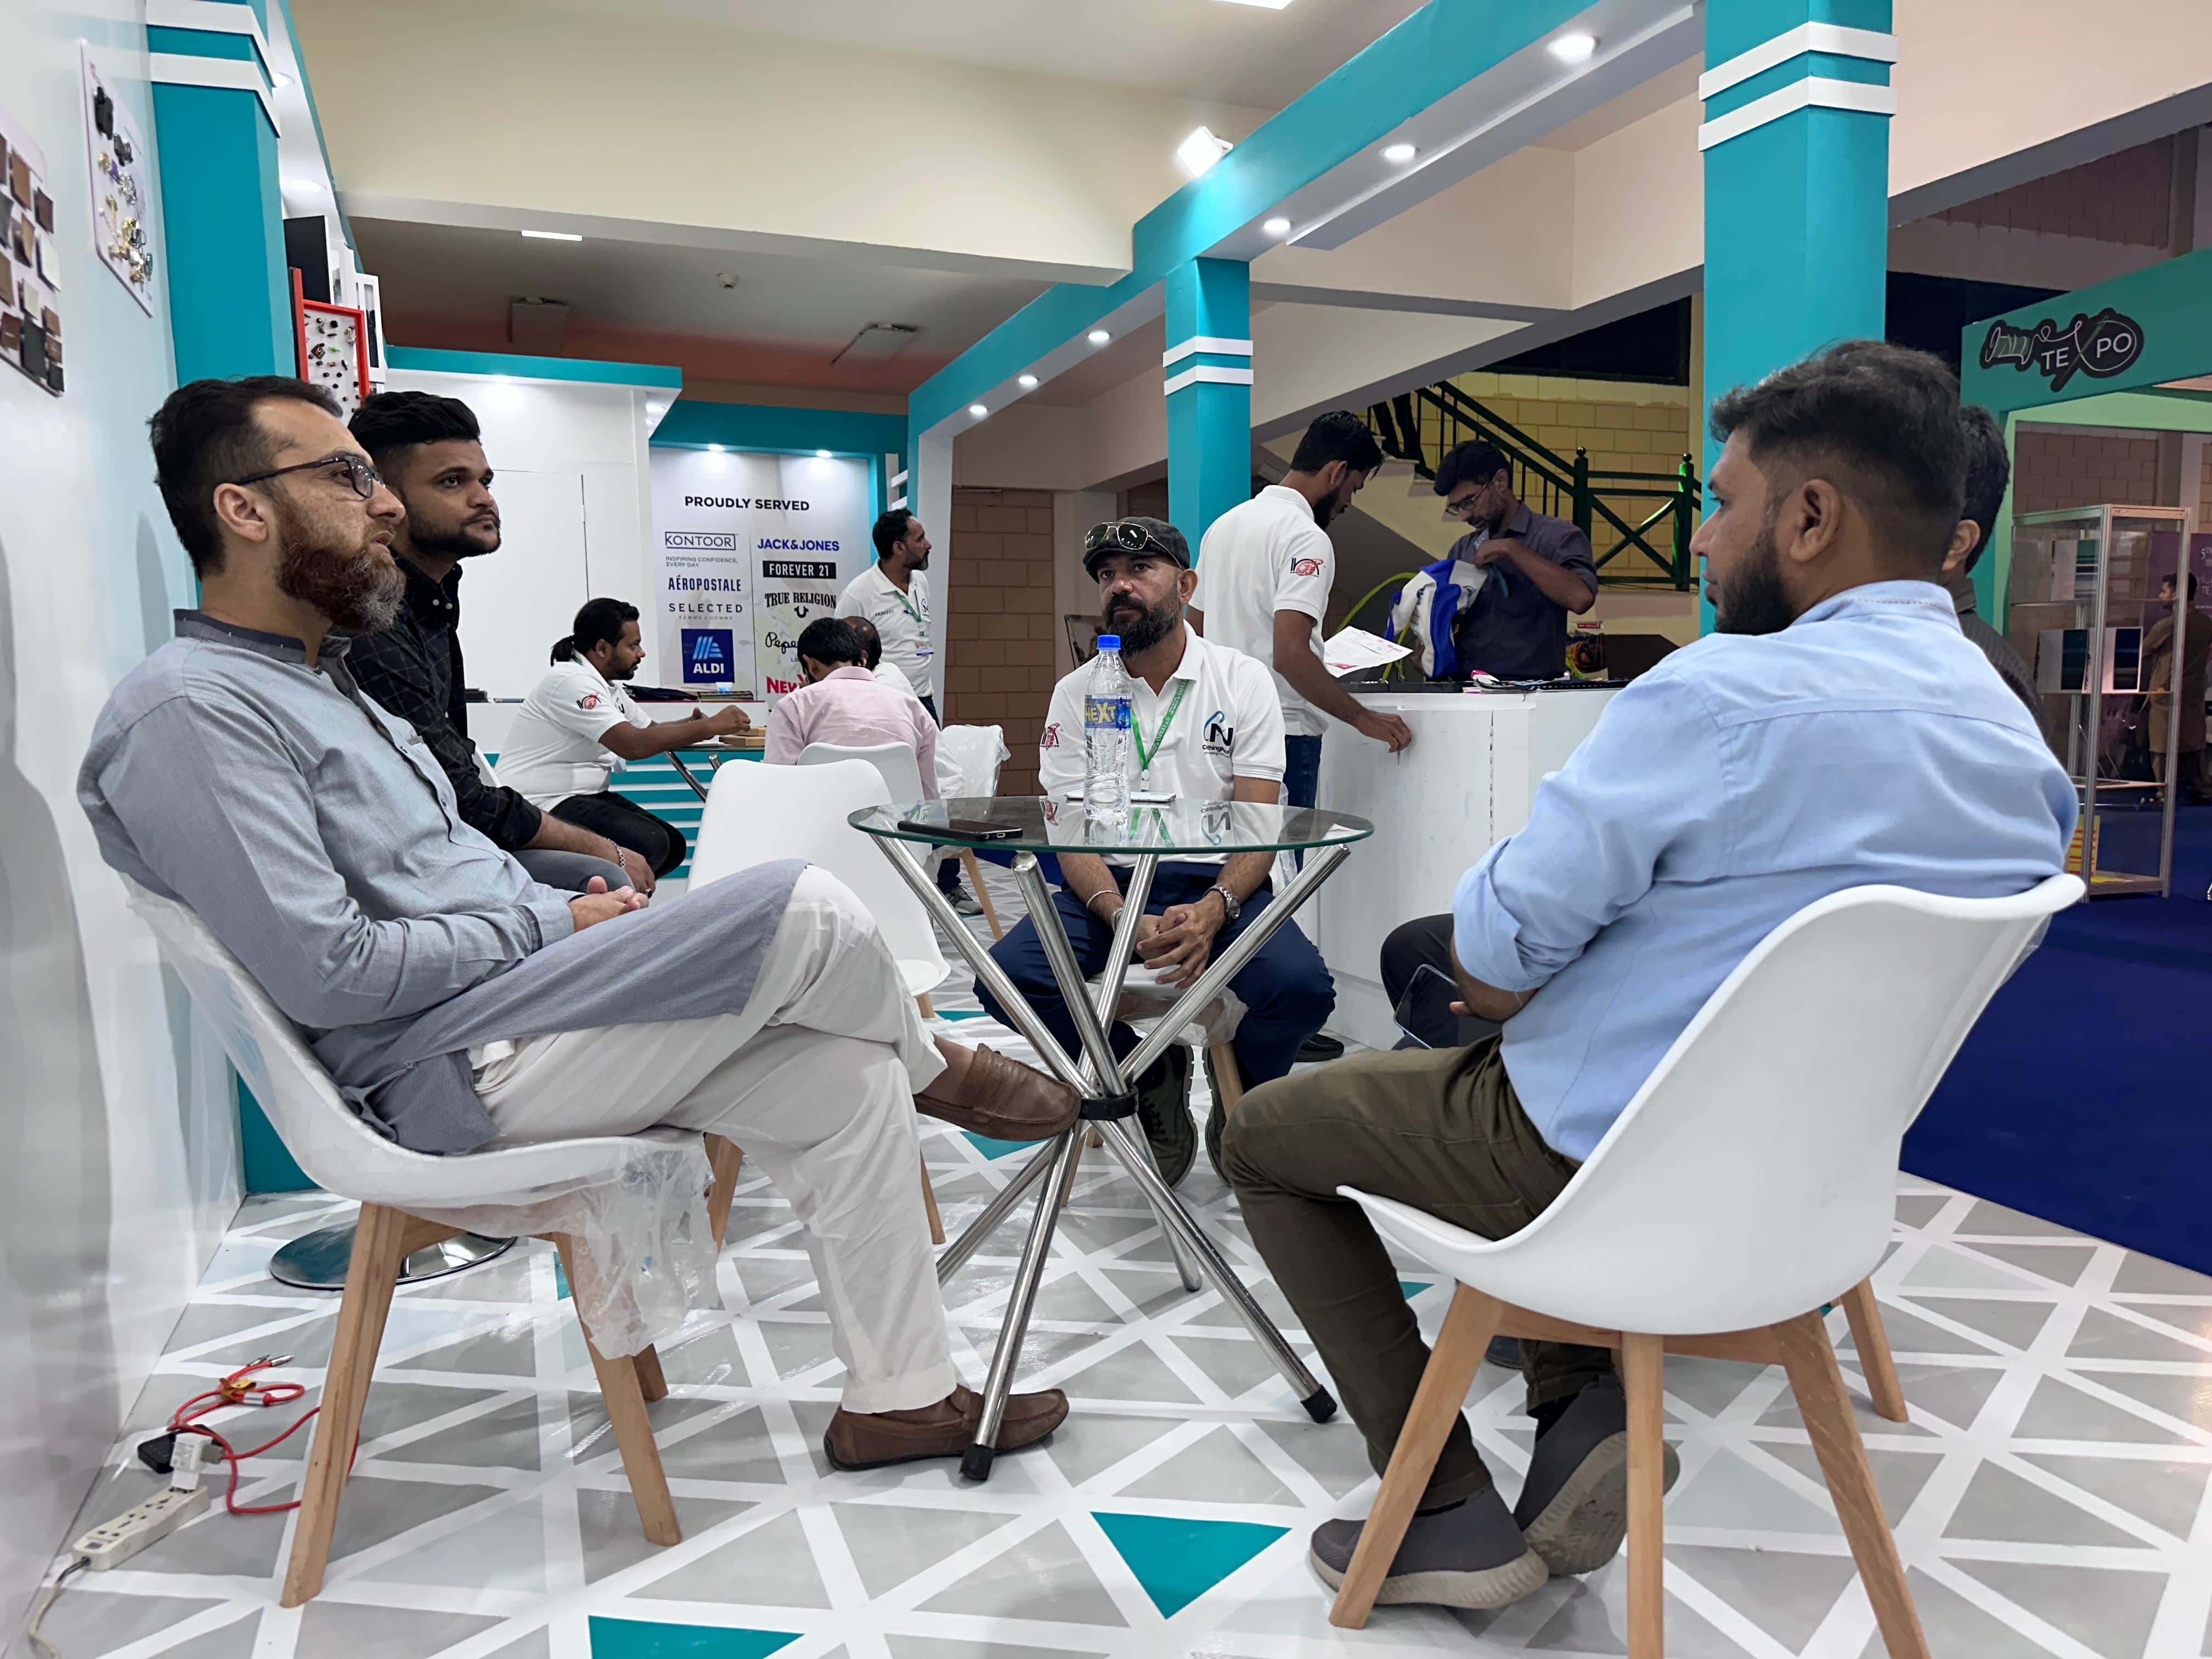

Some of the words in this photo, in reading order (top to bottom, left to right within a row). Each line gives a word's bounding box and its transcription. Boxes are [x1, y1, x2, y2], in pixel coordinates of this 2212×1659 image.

[685, 496, 751, 509] PROUDLY
[755, 499, 810, 511] SERVED
[665, 535, 732, 547] KONTOOR
[758, 538, 840, 551] JACK&JONES
[769, 563, 814, 576] FOREVER
[819, 565, 829, 577] 21
[668, 574, 741, 591] AÉROPOSTALE
[765, 592, 789, 607] TRUE
[793, 592, 837, 609] RELIGION
[669, 603, 742, 613] SELECTED
[765, 632, 798, 654] Pepe
[693, 663, 725, 674] ALDI
[1085, 702, 1116, 724] NEXT
